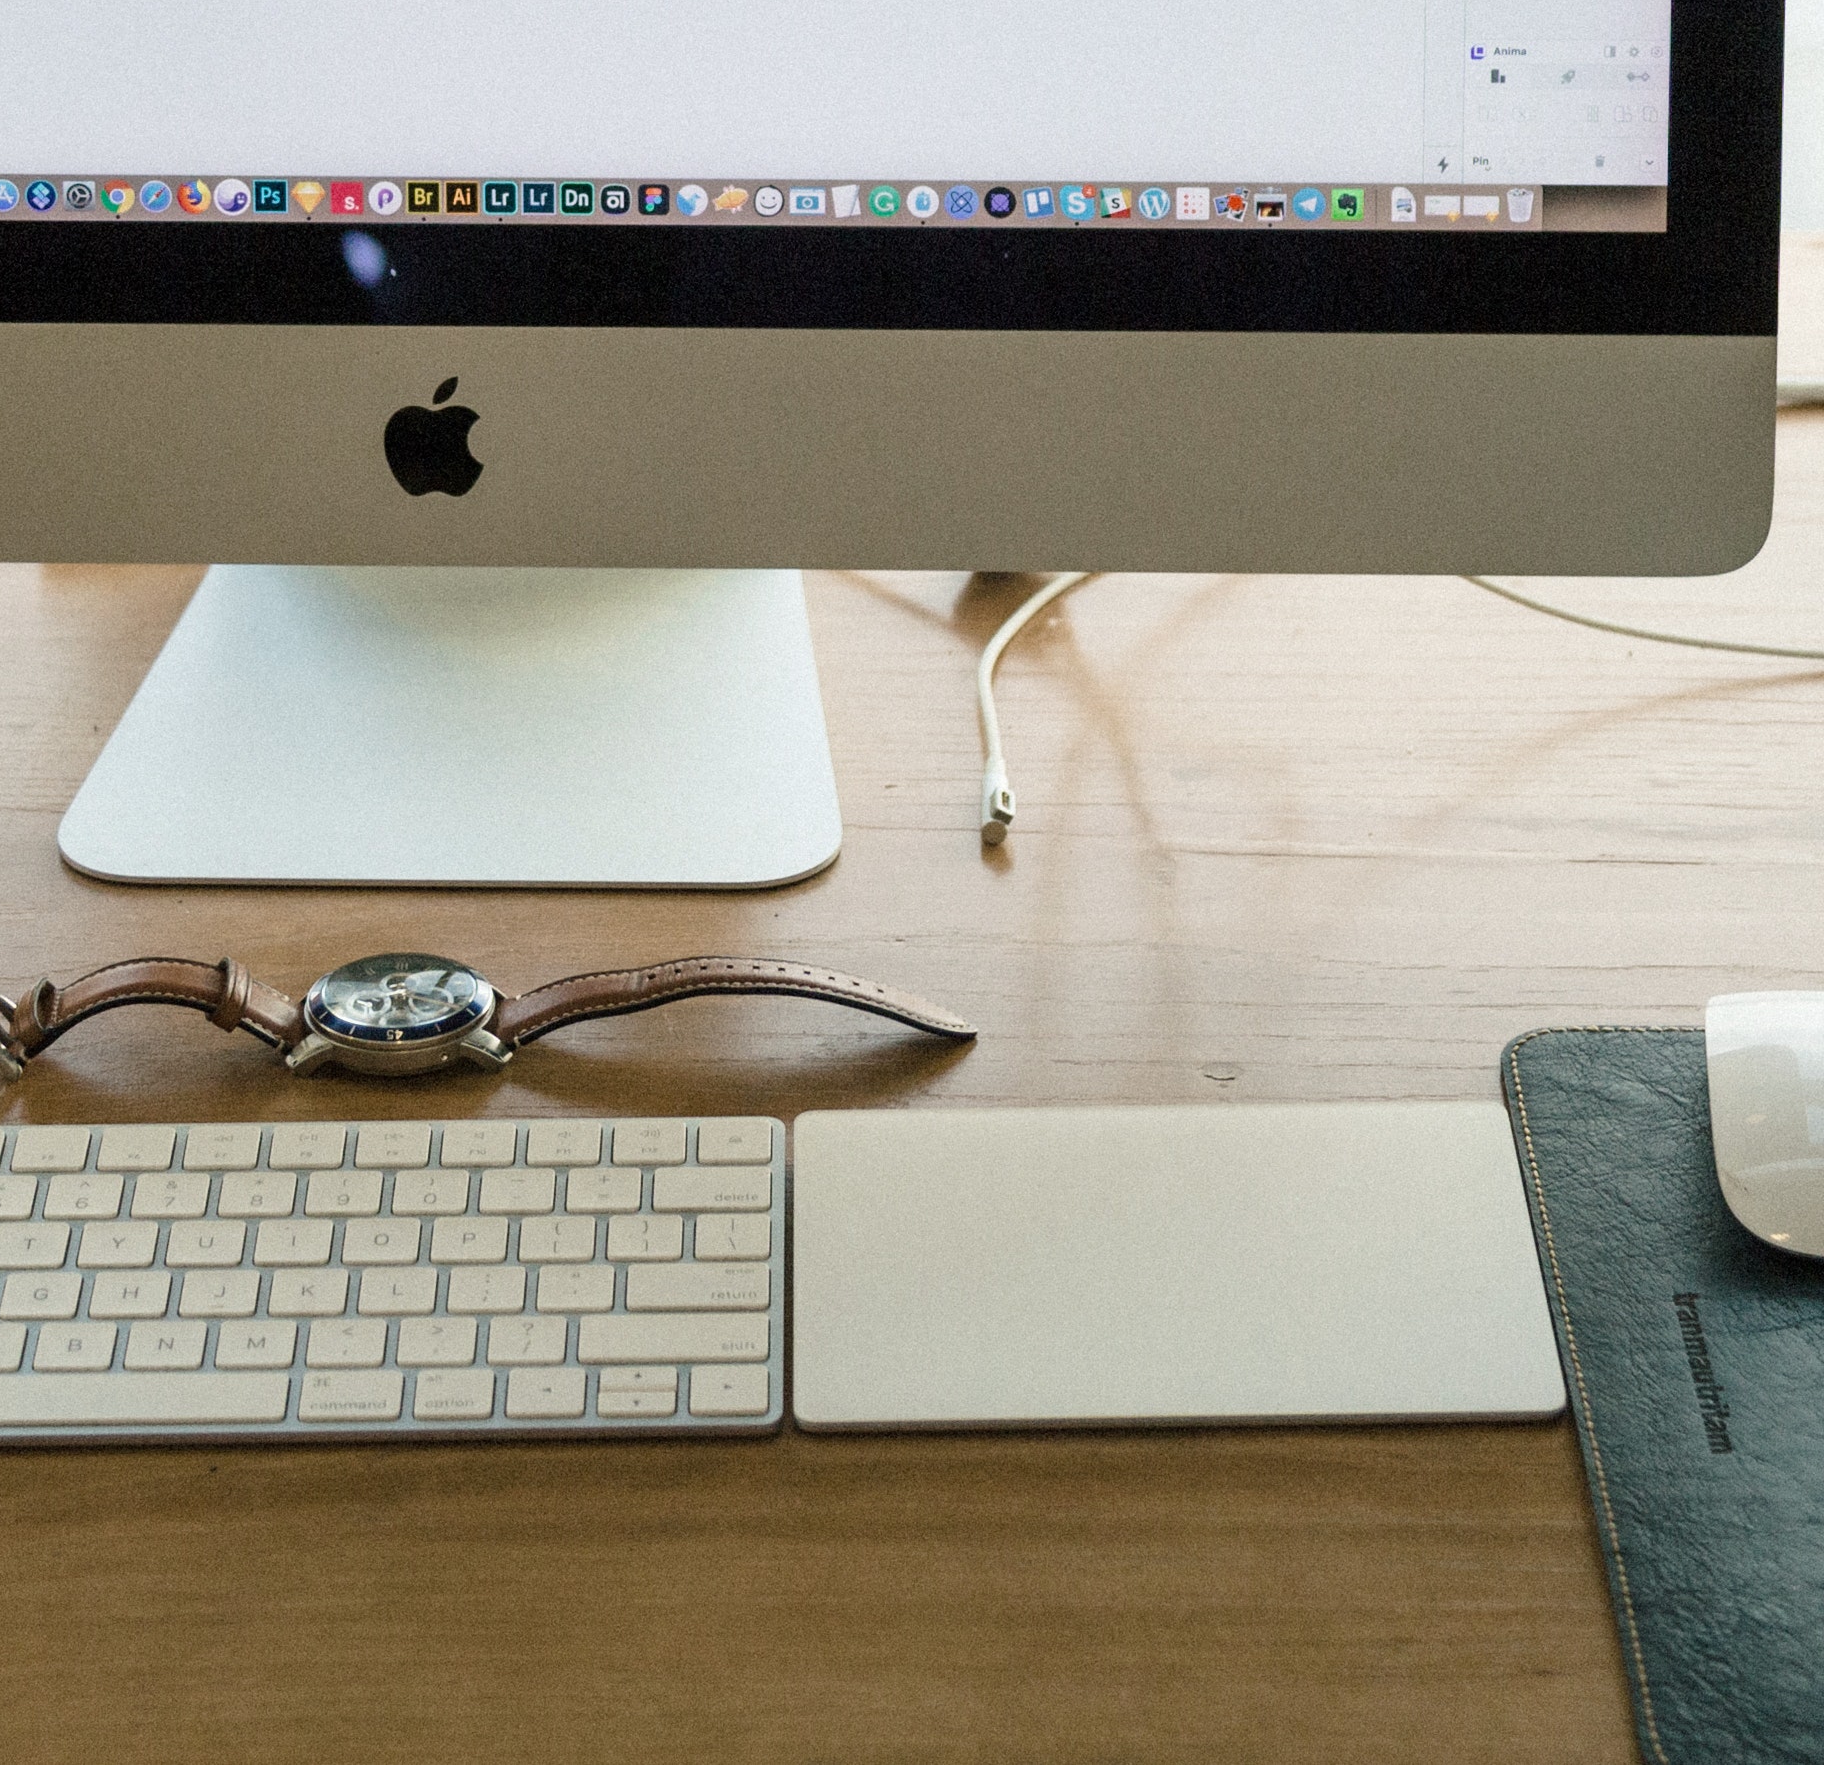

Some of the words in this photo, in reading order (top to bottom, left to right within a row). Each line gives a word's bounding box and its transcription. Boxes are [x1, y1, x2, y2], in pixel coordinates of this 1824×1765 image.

[1494, 47, 1526, 55] Anima
[1473, 157, 1489, 166] Pin
[261, 187, 281, 205] Ps
[414, 188, 433, 205] Br
[453, 188, 472, 206] Ai
[492, 189, 509, 206] Lr
[530, 189, 548, 206] Lr
[564, 189, 591, 208] Dn
[386, 1028, 403, 1041] 45
[24, 1239, 36, 1249] T
[112, 1238, 125, 1248] Y
[199, 1237, 214, 1248] U
[374, 1234, 389, 1245] O
[463, 1233, 476, 1244] P
[1673, 1292, 1733, 1454] tranmautritam
